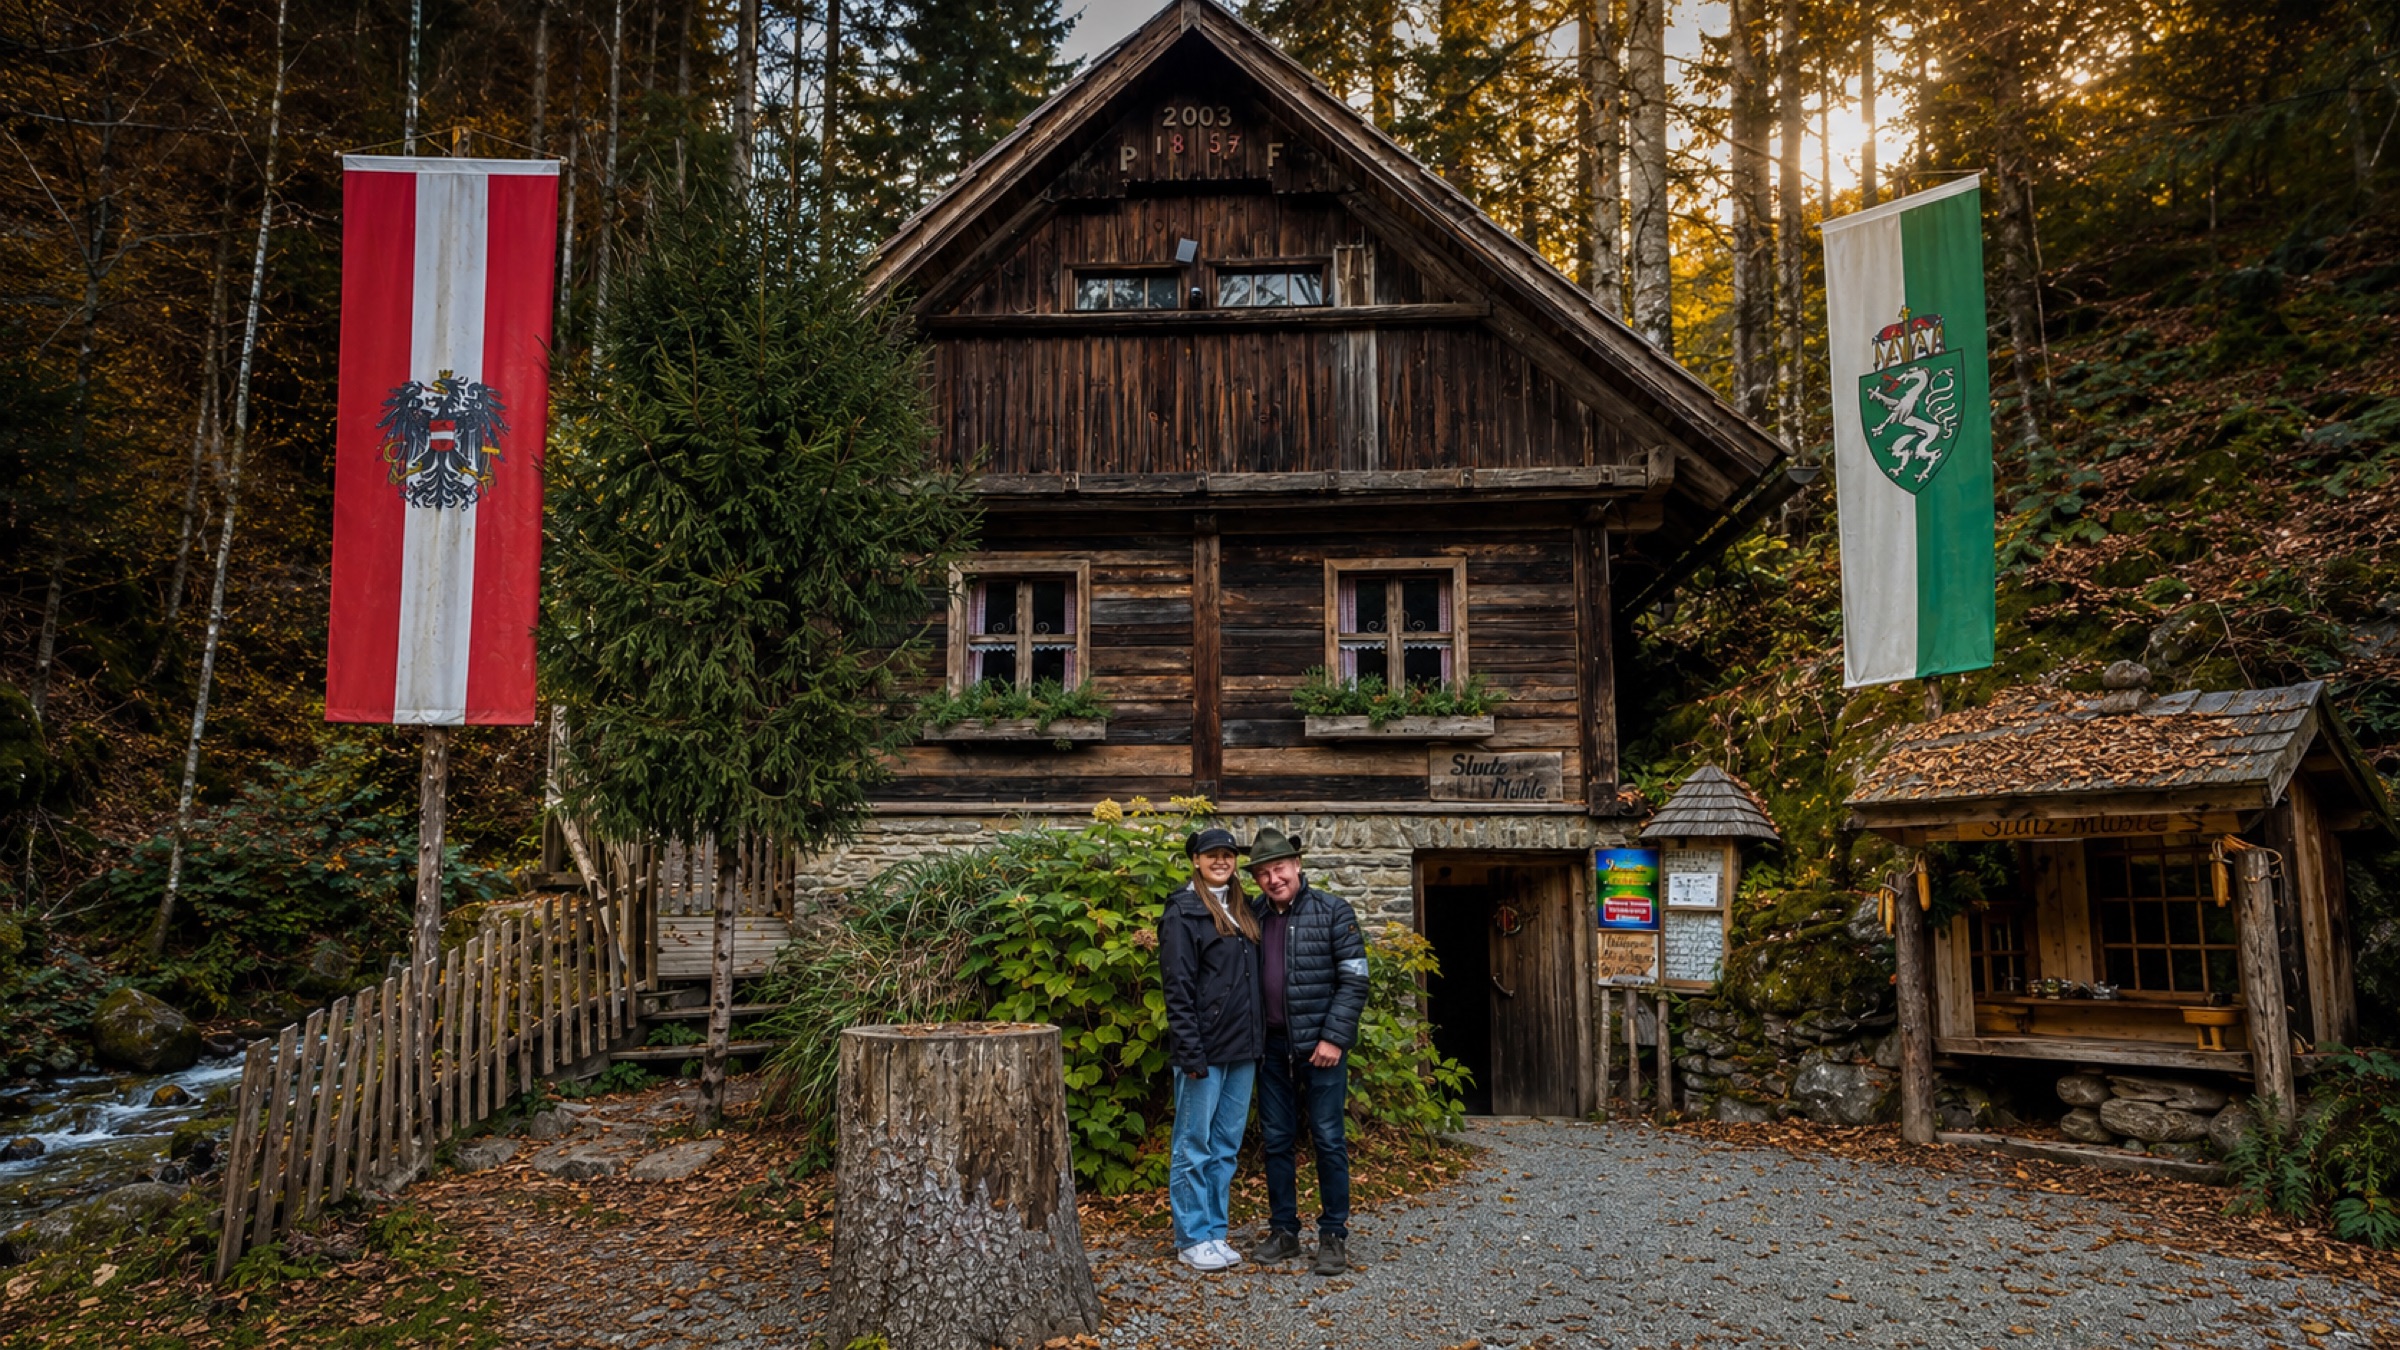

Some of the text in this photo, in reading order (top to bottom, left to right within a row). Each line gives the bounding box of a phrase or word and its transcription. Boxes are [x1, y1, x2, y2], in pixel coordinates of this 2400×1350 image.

[1162, 106, 1232, 127] 2003
[1119, 145, 1138, 172] P
[1267, 142, 1284, 167] F
